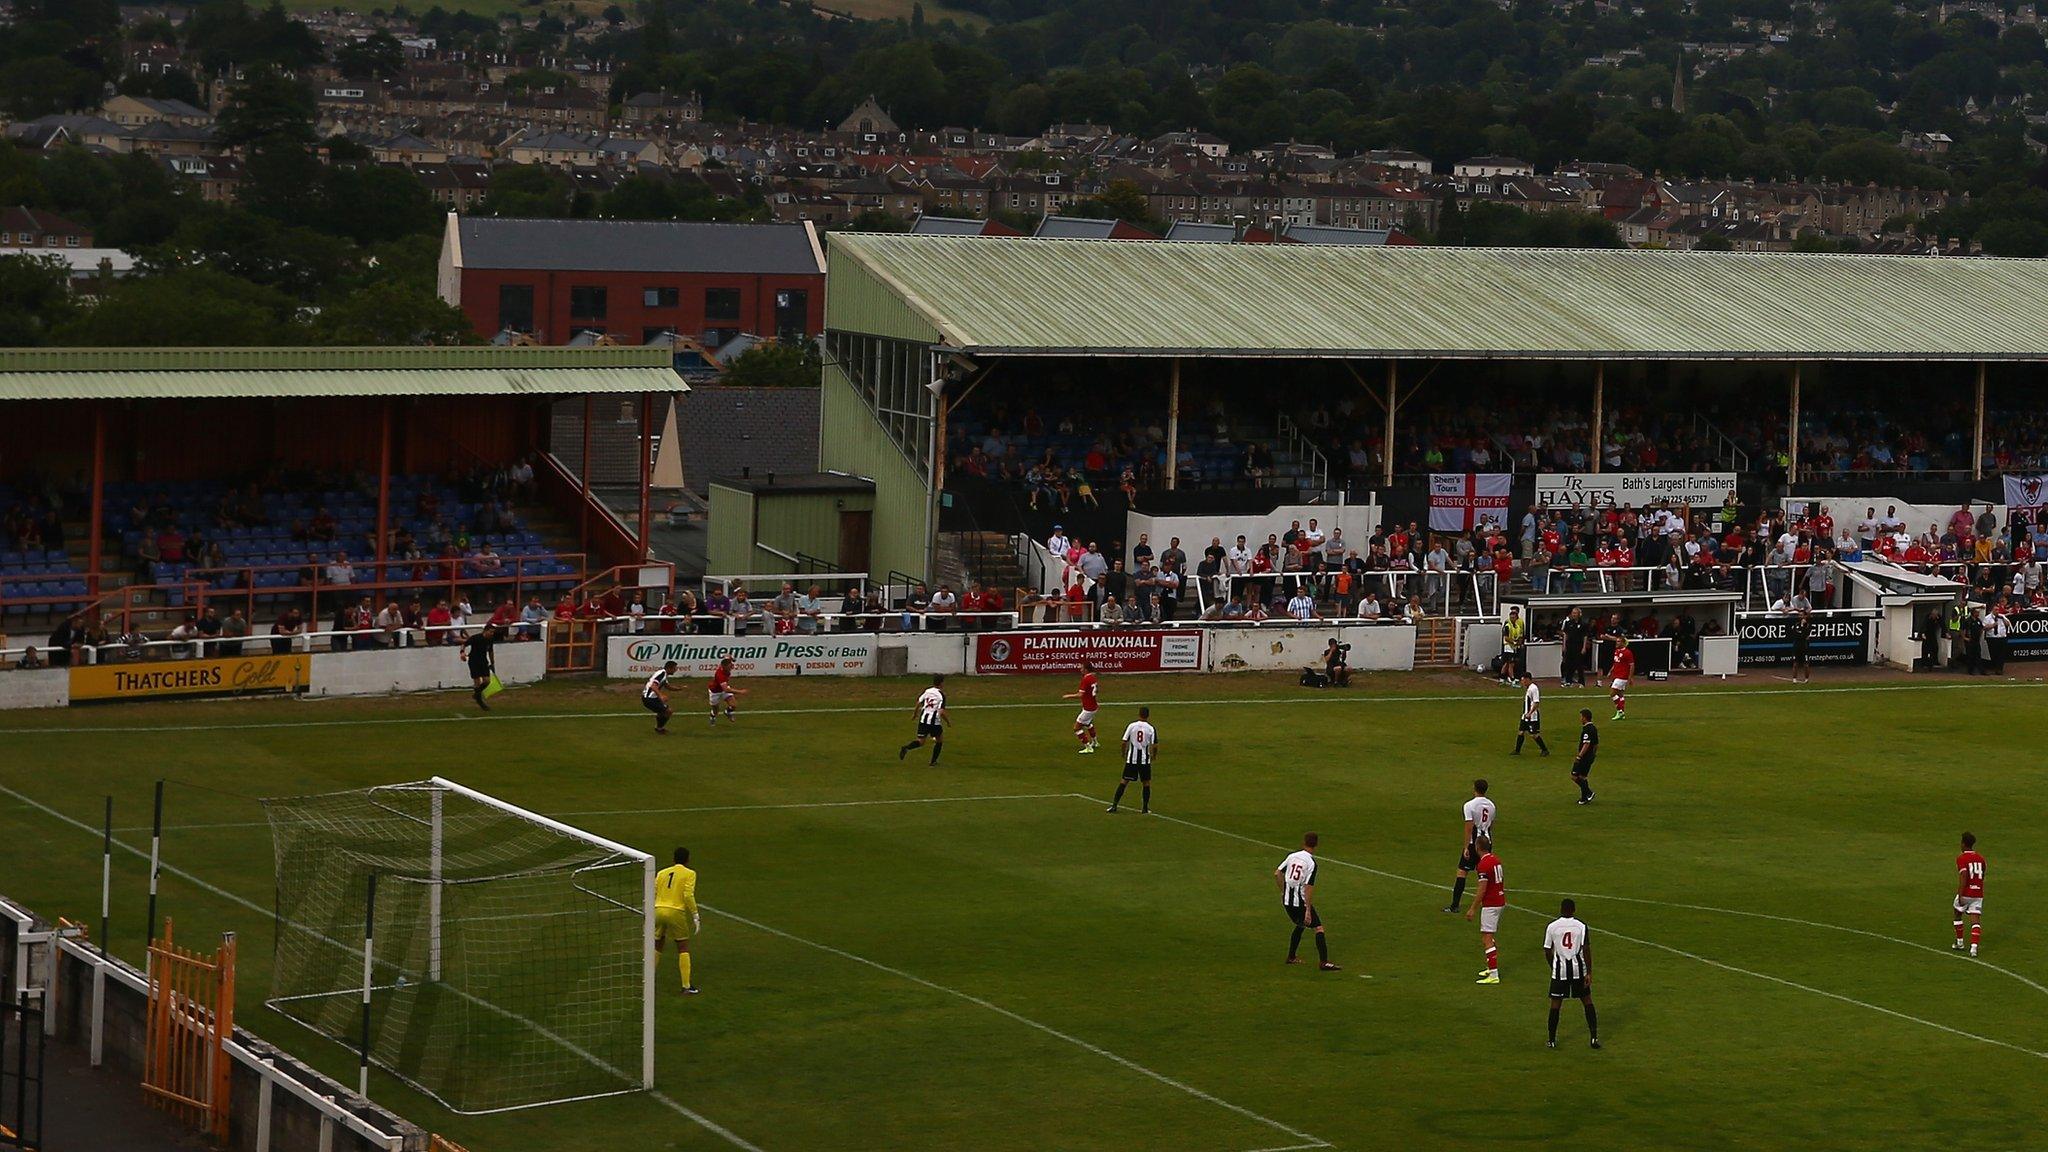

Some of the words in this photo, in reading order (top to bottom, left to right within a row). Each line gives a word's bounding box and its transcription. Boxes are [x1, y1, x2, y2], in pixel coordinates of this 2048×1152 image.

[1433, 475, 1460, 484] Shem's
[1622, 477, 1650, 490] Bath's
[1653, 477, 1685, 492] Largest
[1688, 476, 1734, 489] Furnishers
[1436, 484, 1457, 492] Tours
[1433, 497, 1471, 507] BRISTOL
[1472, 497, 1492, 507] CITY
[1494, 498, 1506, 506] FC
[1539, 490, 1615, 504] HAYES
[1736, 624, 1787, 639] MOORE
[1805, 621, 1864, 638] EPHENS
[1023, 637, 1089, 649] PLATINUM
[1091, 636, 1158, 648] VAUXHALL
[663, 643, 768, 660] Minuteman
[774, 642, 824, 658] Press
[827, 648, 839, 658] of
[841, 647, 868, 657] Bath
[1022, 652, 1045, 660] SALES
[1050, 652, 1079, 660] SERVICE
[1085, 651, 1108, 659] PARTS
[1113, 650, 1152, 659] BODYSHOP
[806, 661, 835, 669] DESIGN
[843, 660, 865, 668] COPY
[114, 667, 223, 691] THATCHERS
[232, 660, 279, 694] Gold
[1136, 731, 1144, 743] 8
[1480, 808, 1489, 822] 6
[1291, 864, 1304, 881] 15
[1968, 862, 1983, 880] 14
[668, 872, 675, 889] 1
[1562, 932, 1573, 950] 4
